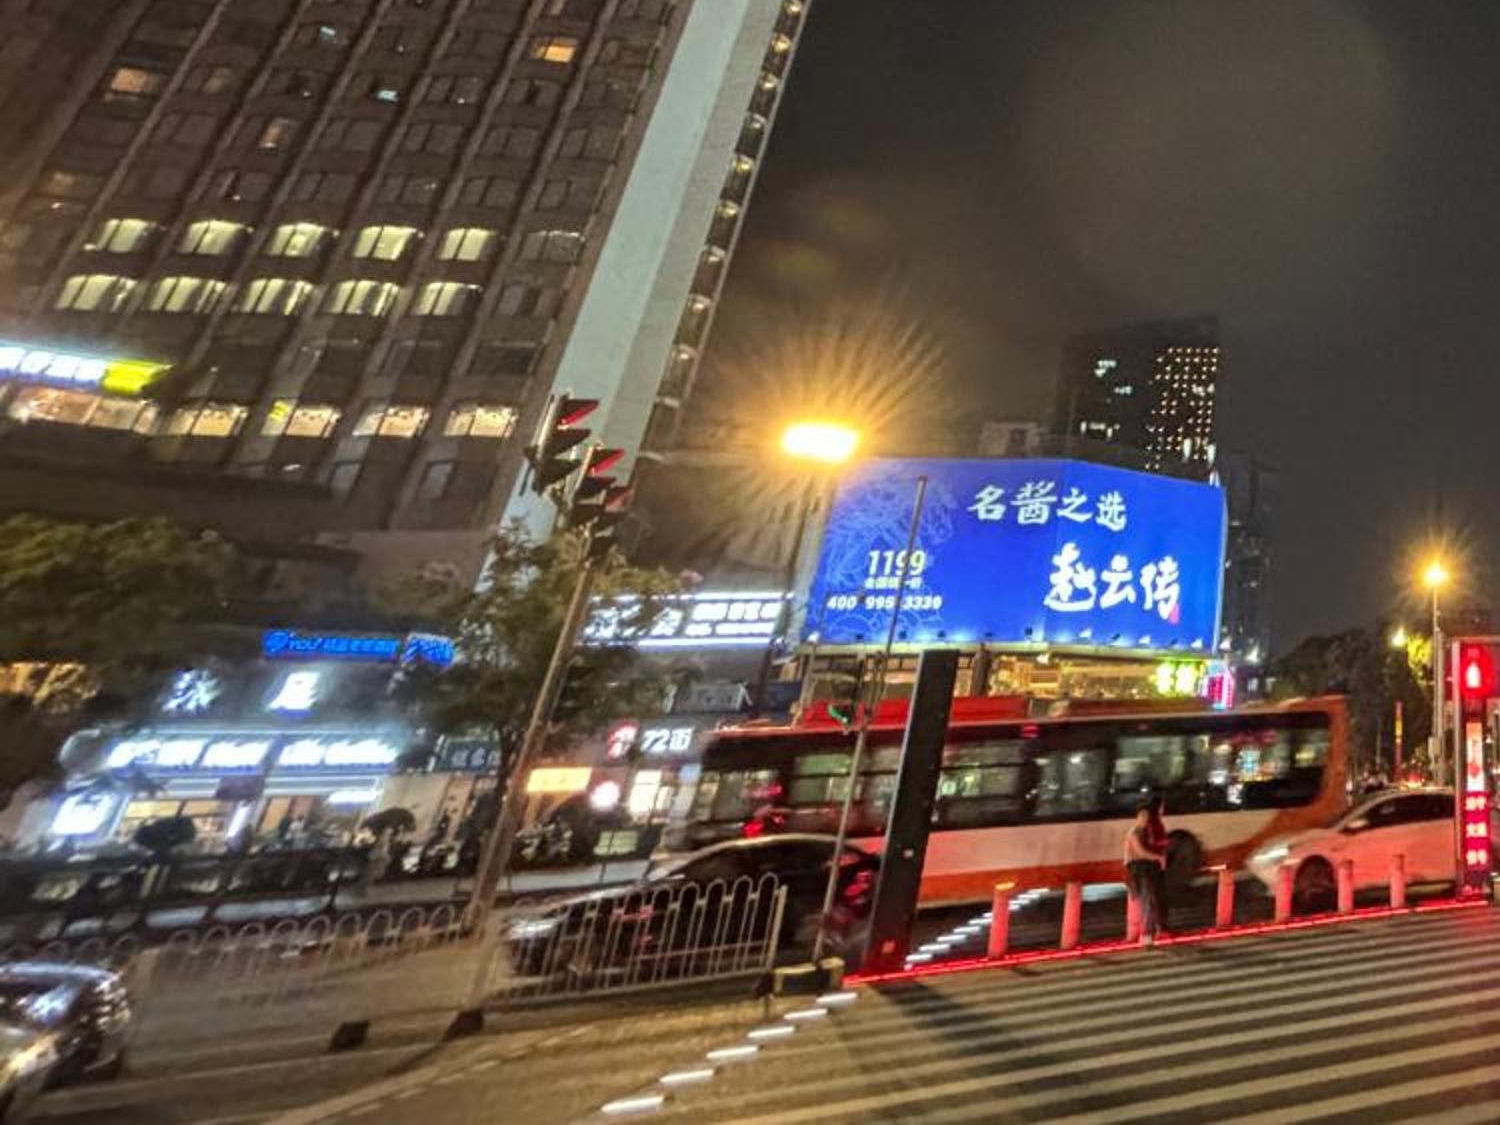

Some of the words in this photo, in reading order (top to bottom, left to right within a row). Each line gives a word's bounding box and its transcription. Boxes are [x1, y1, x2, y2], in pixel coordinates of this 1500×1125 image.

[967, 480, 1127, 532] 名酱之选
[868, 550, 927, 576] 1199
[826, 595, 857, 610] 400
